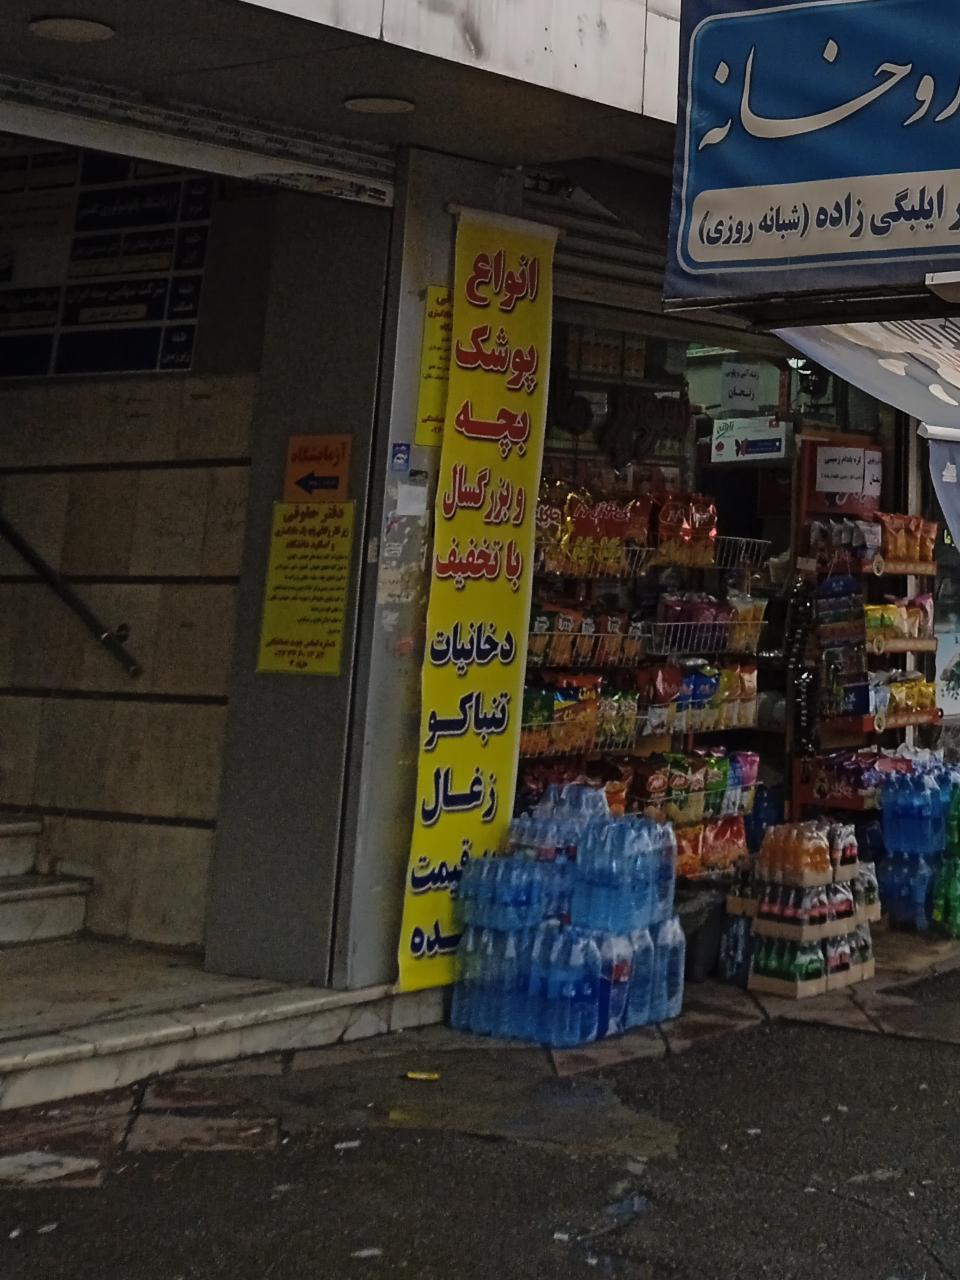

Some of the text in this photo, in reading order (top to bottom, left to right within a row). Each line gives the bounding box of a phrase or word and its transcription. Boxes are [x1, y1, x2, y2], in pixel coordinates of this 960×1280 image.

[697, 210, 754, 247] روزی)
[758, 202, 810, 240] (شبانه
[814, 191, 864, 239] زاده
[869, 185, 945, 236] ایلبگی
[465, 249, 540, 310] انواع
[455, 324, 538, 393] پوشک
[454, 399, 530, 457] بچه
[283, 504, 320, 524] حقوقی
[442, 462, 512, 525] بزرگسال
[511, 487, 526, 525] و
[435, 536, 523, 590] با تخفیف
[430, 621, 516, 675] دخانیات
[423, 690, 512, 751] تنباکو
[421, 765, 497, 826] زغال
